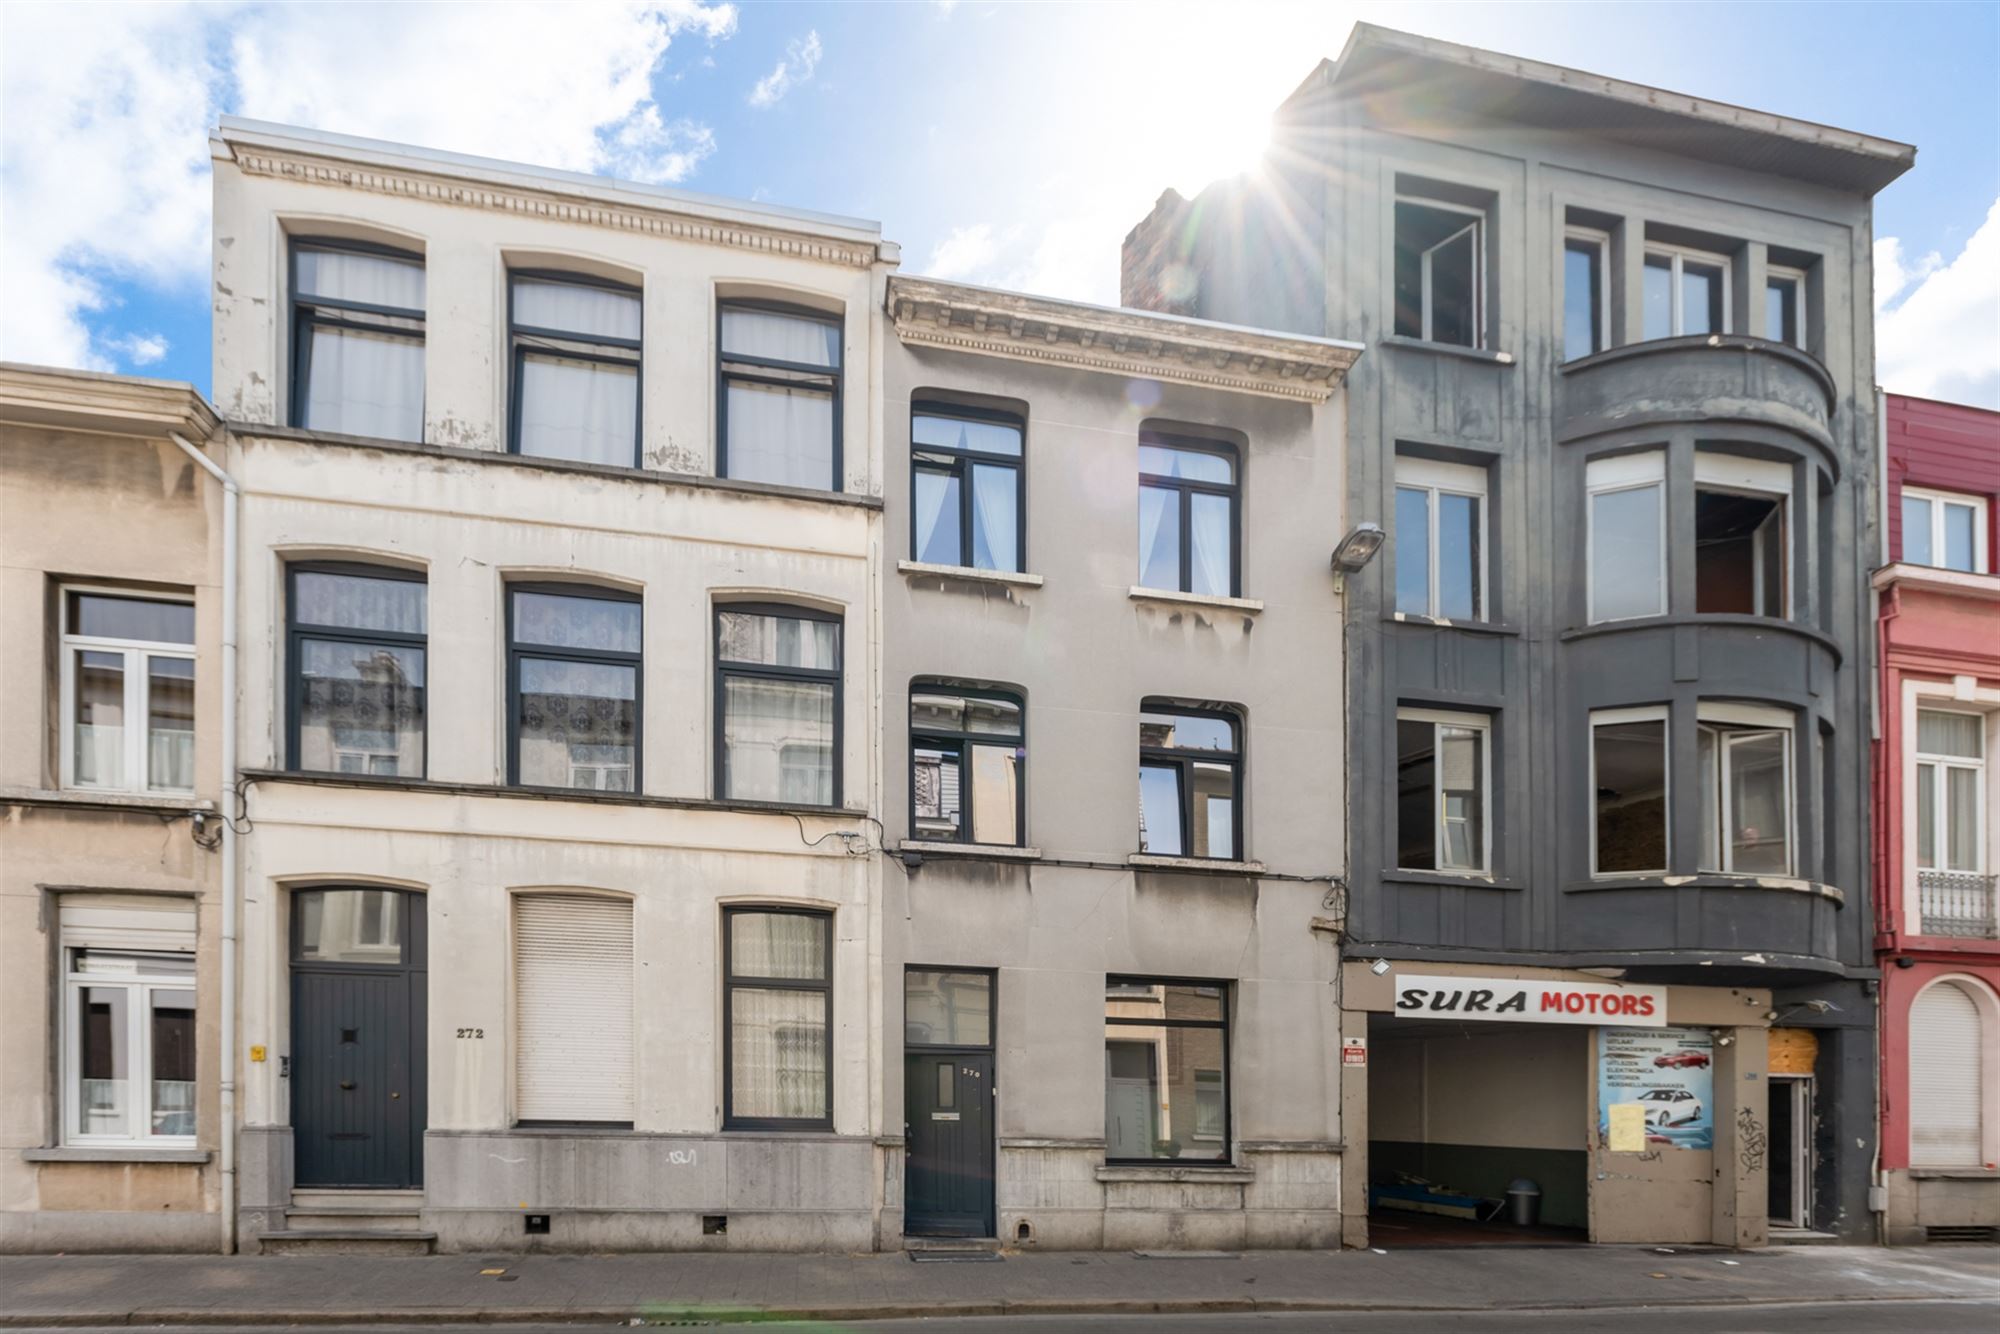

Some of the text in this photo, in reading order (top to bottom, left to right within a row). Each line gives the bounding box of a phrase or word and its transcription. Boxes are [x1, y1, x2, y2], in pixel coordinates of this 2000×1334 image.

[1396, 988, 1655, 1016] SURA MOTORS
[456, 1028, 484, 1039] 272
[1606, 1031, 1649, 1039] ONDERHOUD
[1658, 1032, 1686, 1040] SERVICE
